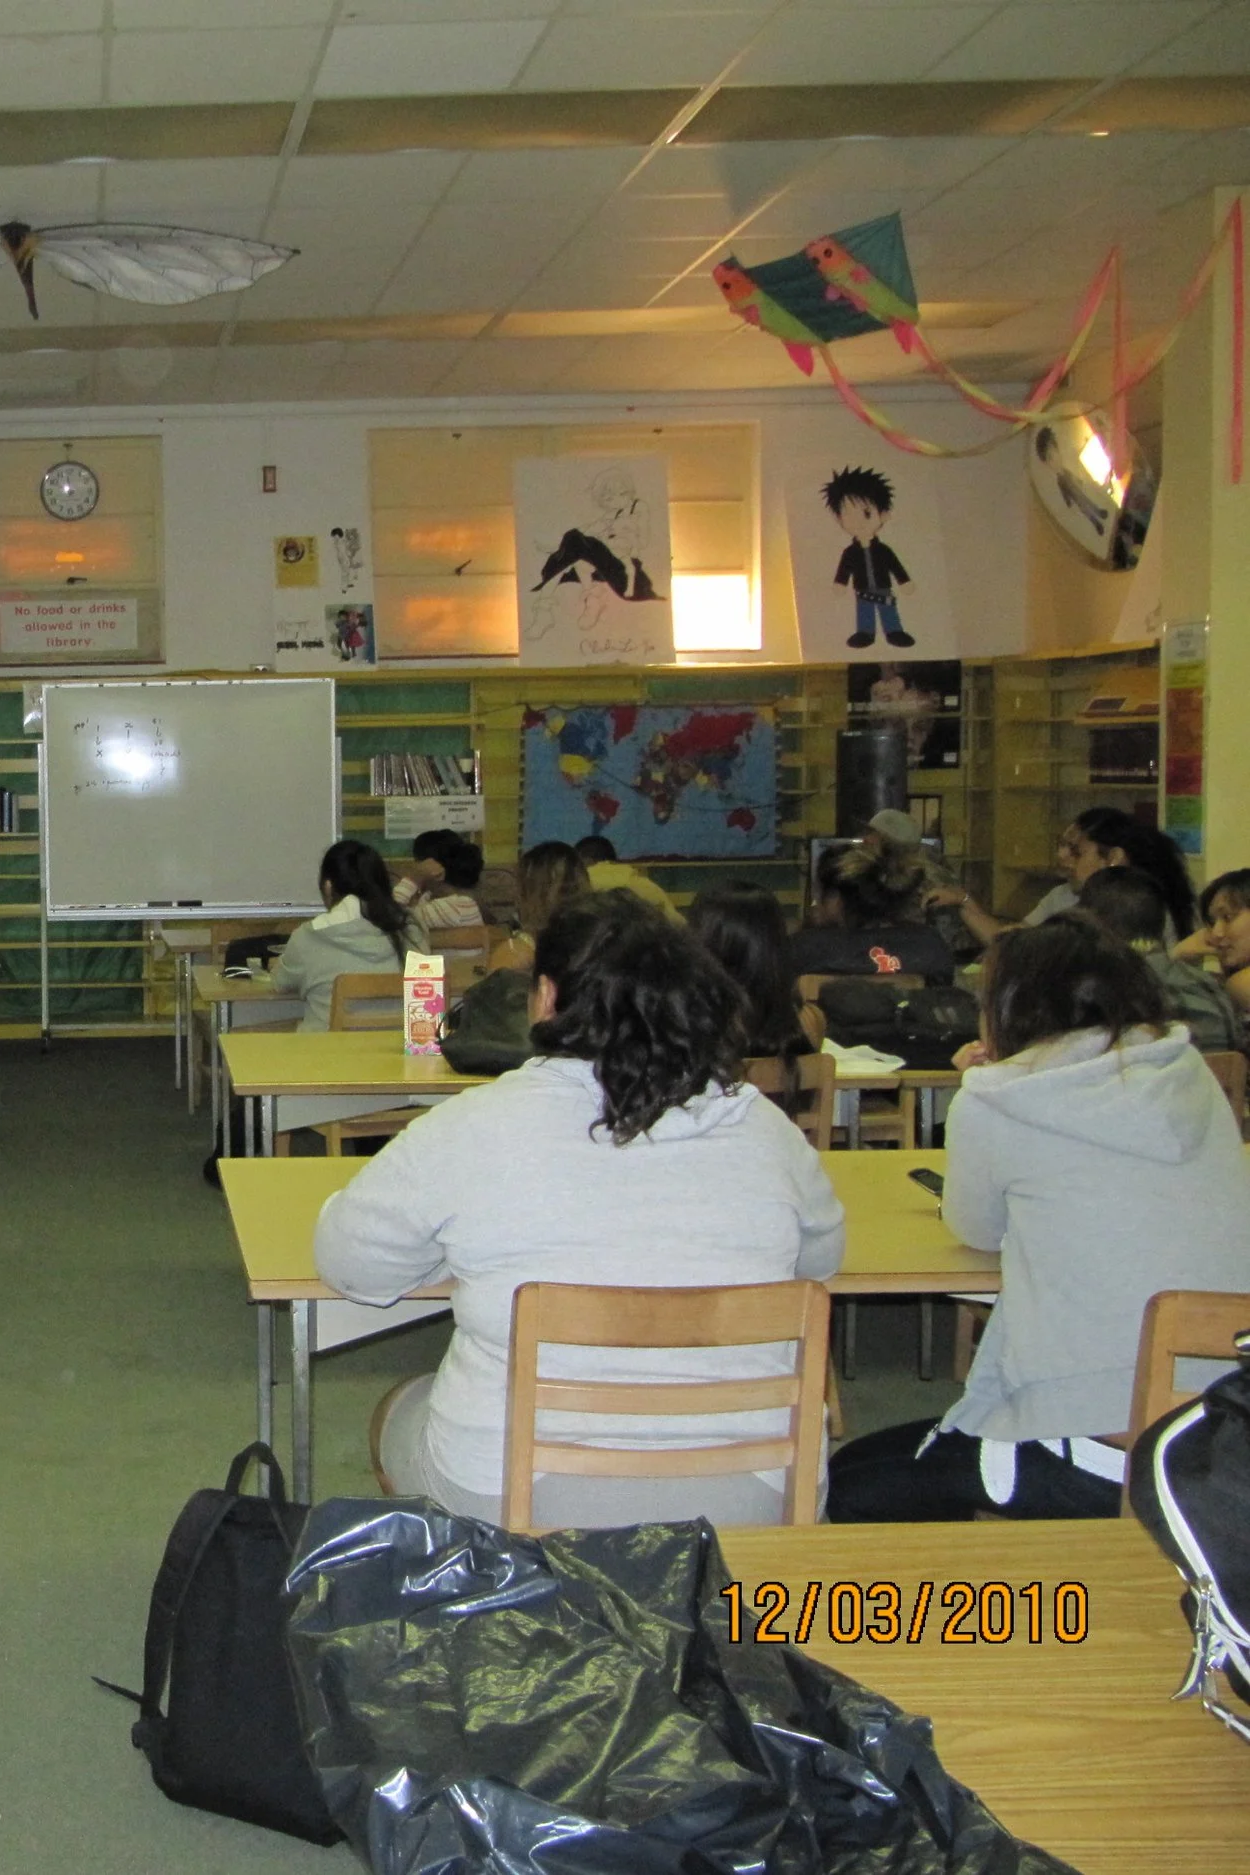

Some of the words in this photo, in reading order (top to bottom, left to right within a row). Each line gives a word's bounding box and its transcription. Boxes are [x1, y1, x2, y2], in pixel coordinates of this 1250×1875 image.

[14, 606, 30, 616] No
[37, 605, 63, 616] food
[69, 606, 82, 614] or
[89, 603, 126, 614] drinks
[24, 621, 73, 632] allowed
[80, 620, 90, 630] in
[97, 619, 116, 630] the
